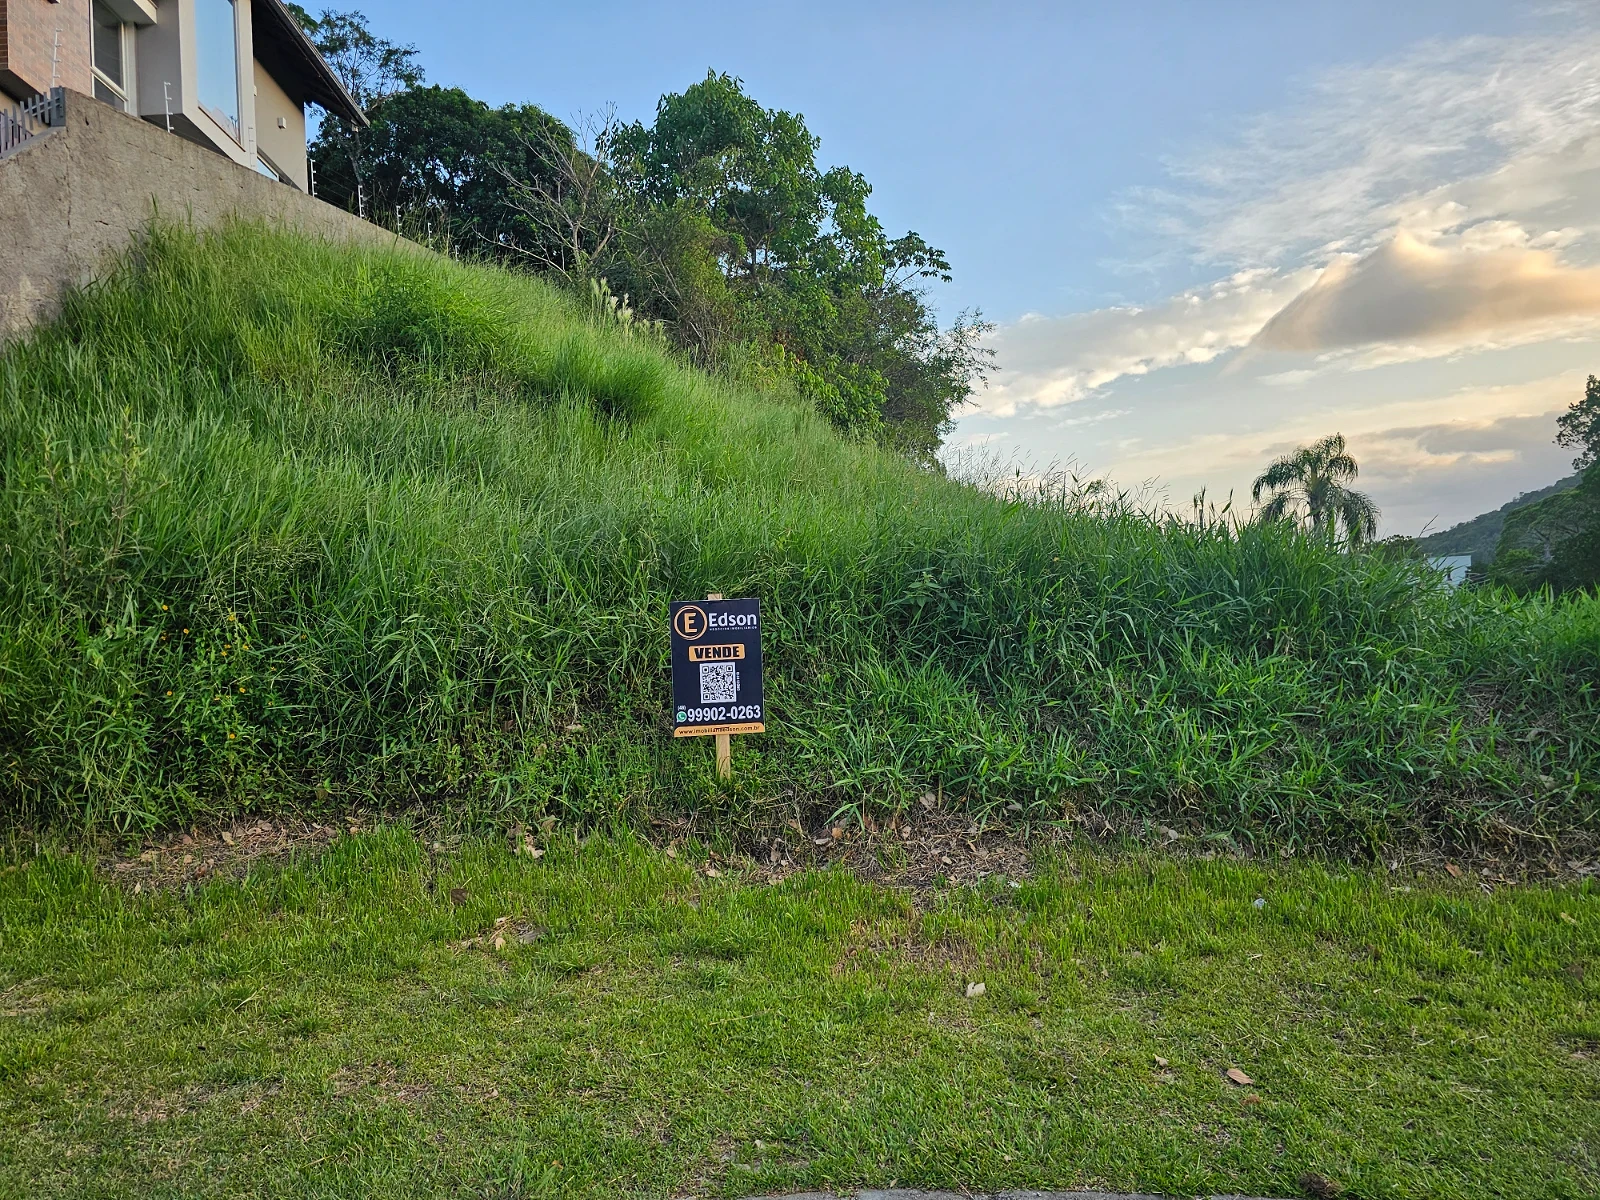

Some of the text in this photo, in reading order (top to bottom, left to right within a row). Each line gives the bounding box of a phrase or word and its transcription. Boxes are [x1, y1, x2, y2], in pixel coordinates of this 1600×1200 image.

[684, 612, 698, 633] E
[708, 612, 757, 627] Edson
[694, 646, 740, 659] VENDE
[687, 705, 761, 722] 99902-0263
